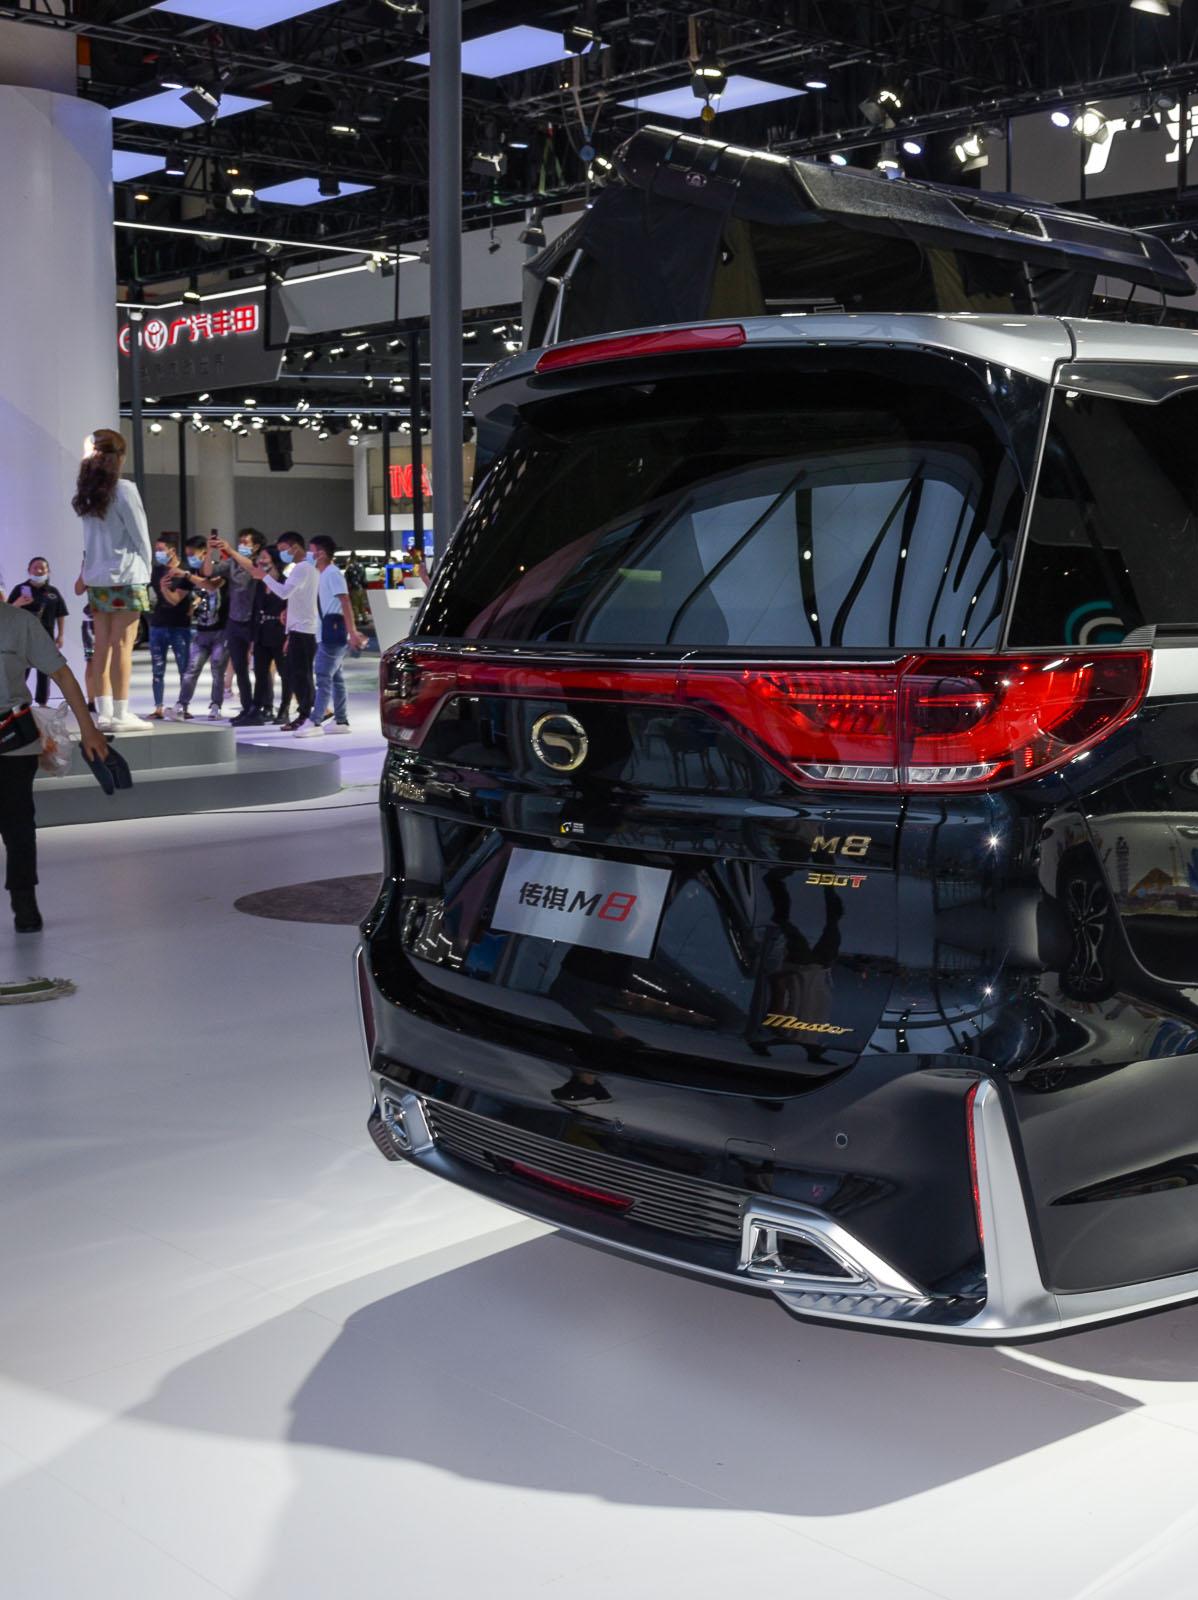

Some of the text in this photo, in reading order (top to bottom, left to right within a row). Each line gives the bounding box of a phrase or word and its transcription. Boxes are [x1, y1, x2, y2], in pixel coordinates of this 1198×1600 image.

[168, 304, 259, 346] 广汽丰田
[810, 835, 872, 856] M8
[805, 872, 868, 888] 390T
[518, 881, 638, 922] 传祺M8
[761, 1013, 854, 1035] Master
